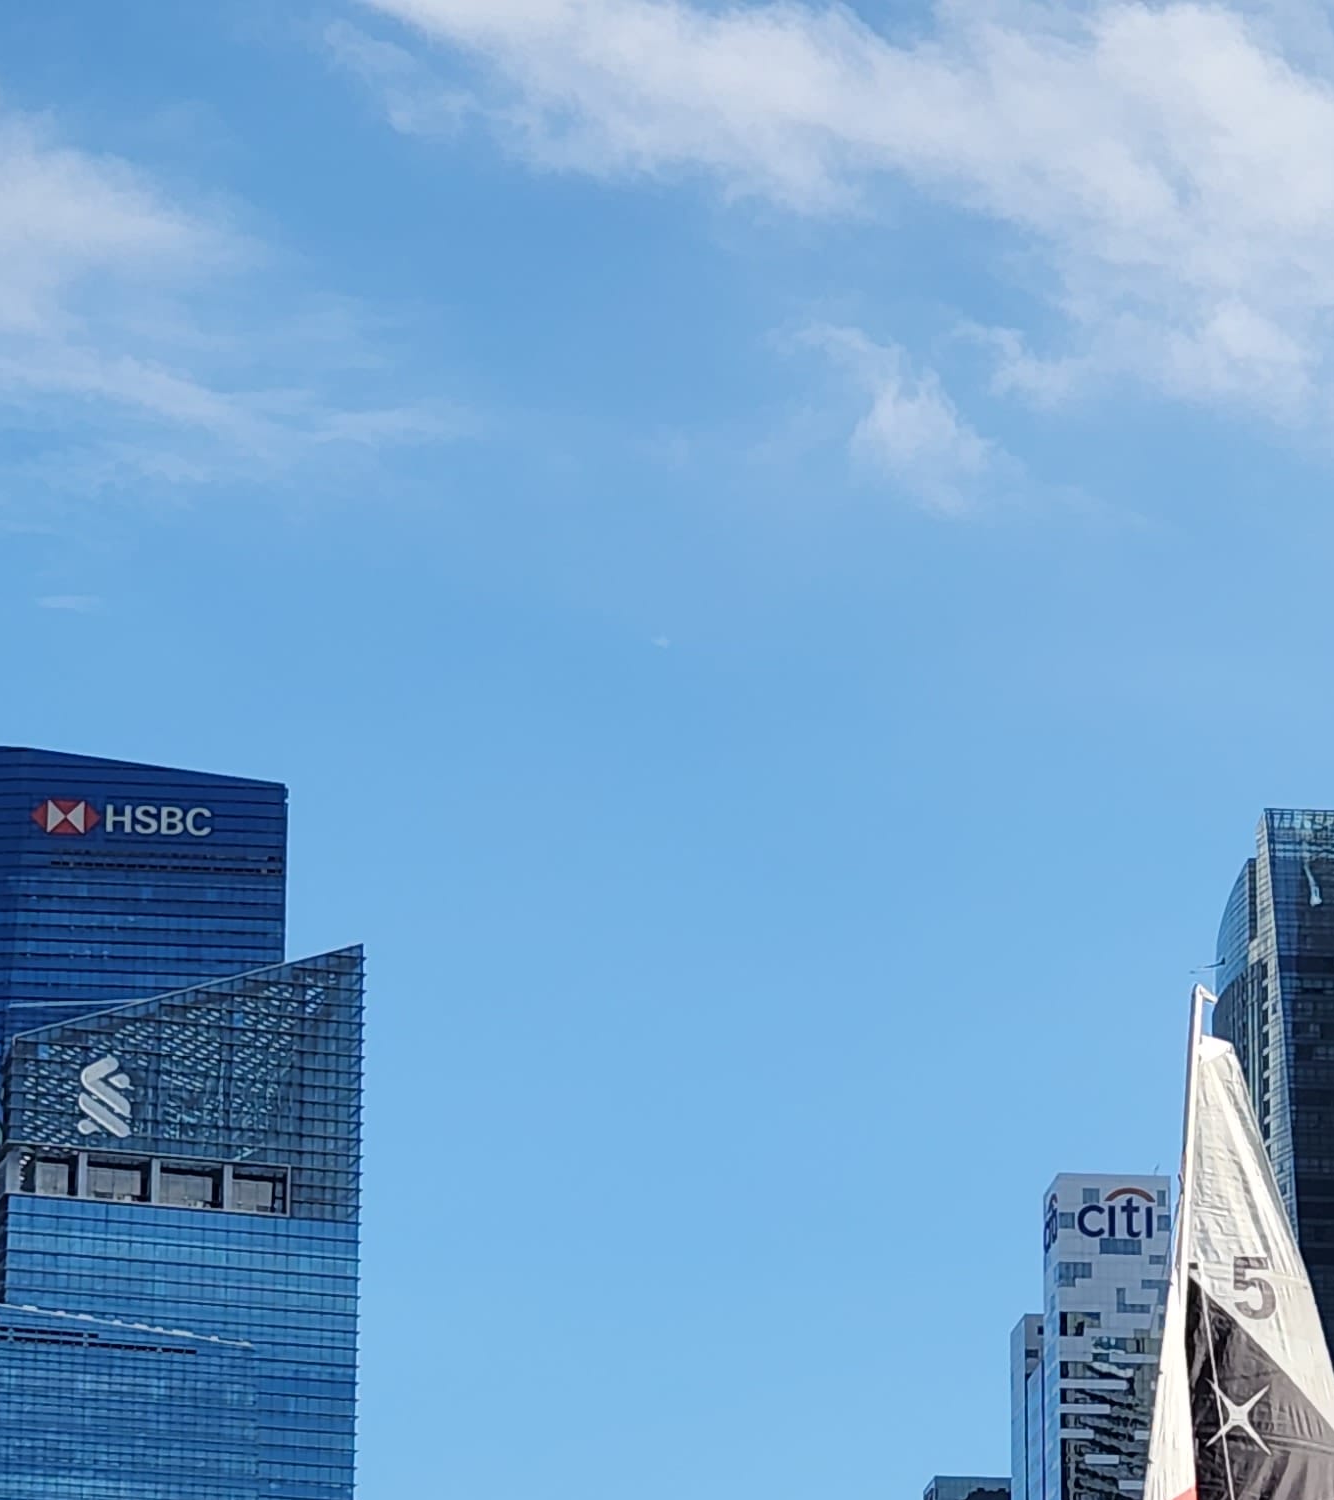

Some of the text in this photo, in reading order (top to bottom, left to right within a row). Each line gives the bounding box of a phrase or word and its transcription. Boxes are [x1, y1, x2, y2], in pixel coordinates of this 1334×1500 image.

[105, 804, 212, 837] HSBC
[1077, 1194, 1154, 1239] citi
[1233, 1255, 1277, 1320] 5
